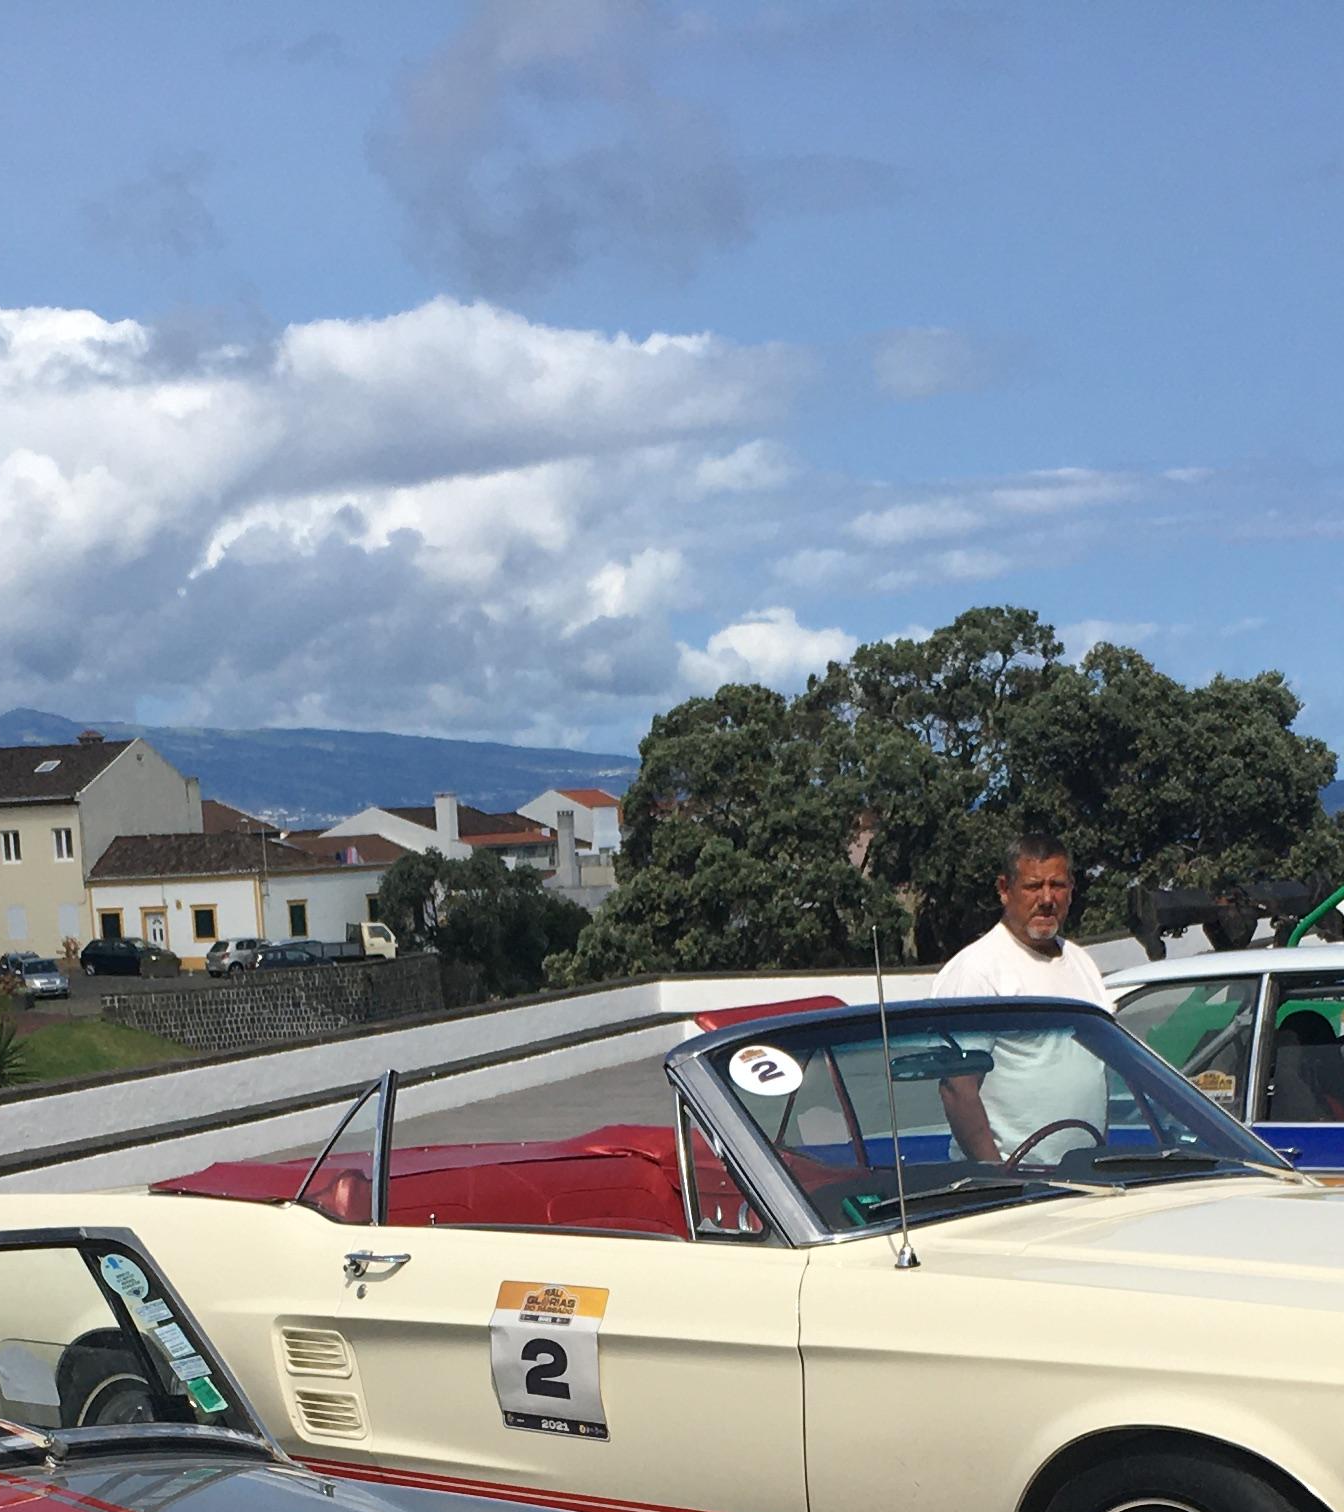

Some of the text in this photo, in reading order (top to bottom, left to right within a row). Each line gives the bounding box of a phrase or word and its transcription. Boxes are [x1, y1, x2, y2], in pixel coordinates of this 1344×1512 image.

[751, 1060, 785, 1083] 2
[521, 1338, 571, 1400] 2
[541, 1419, 570, 1432] 2021
